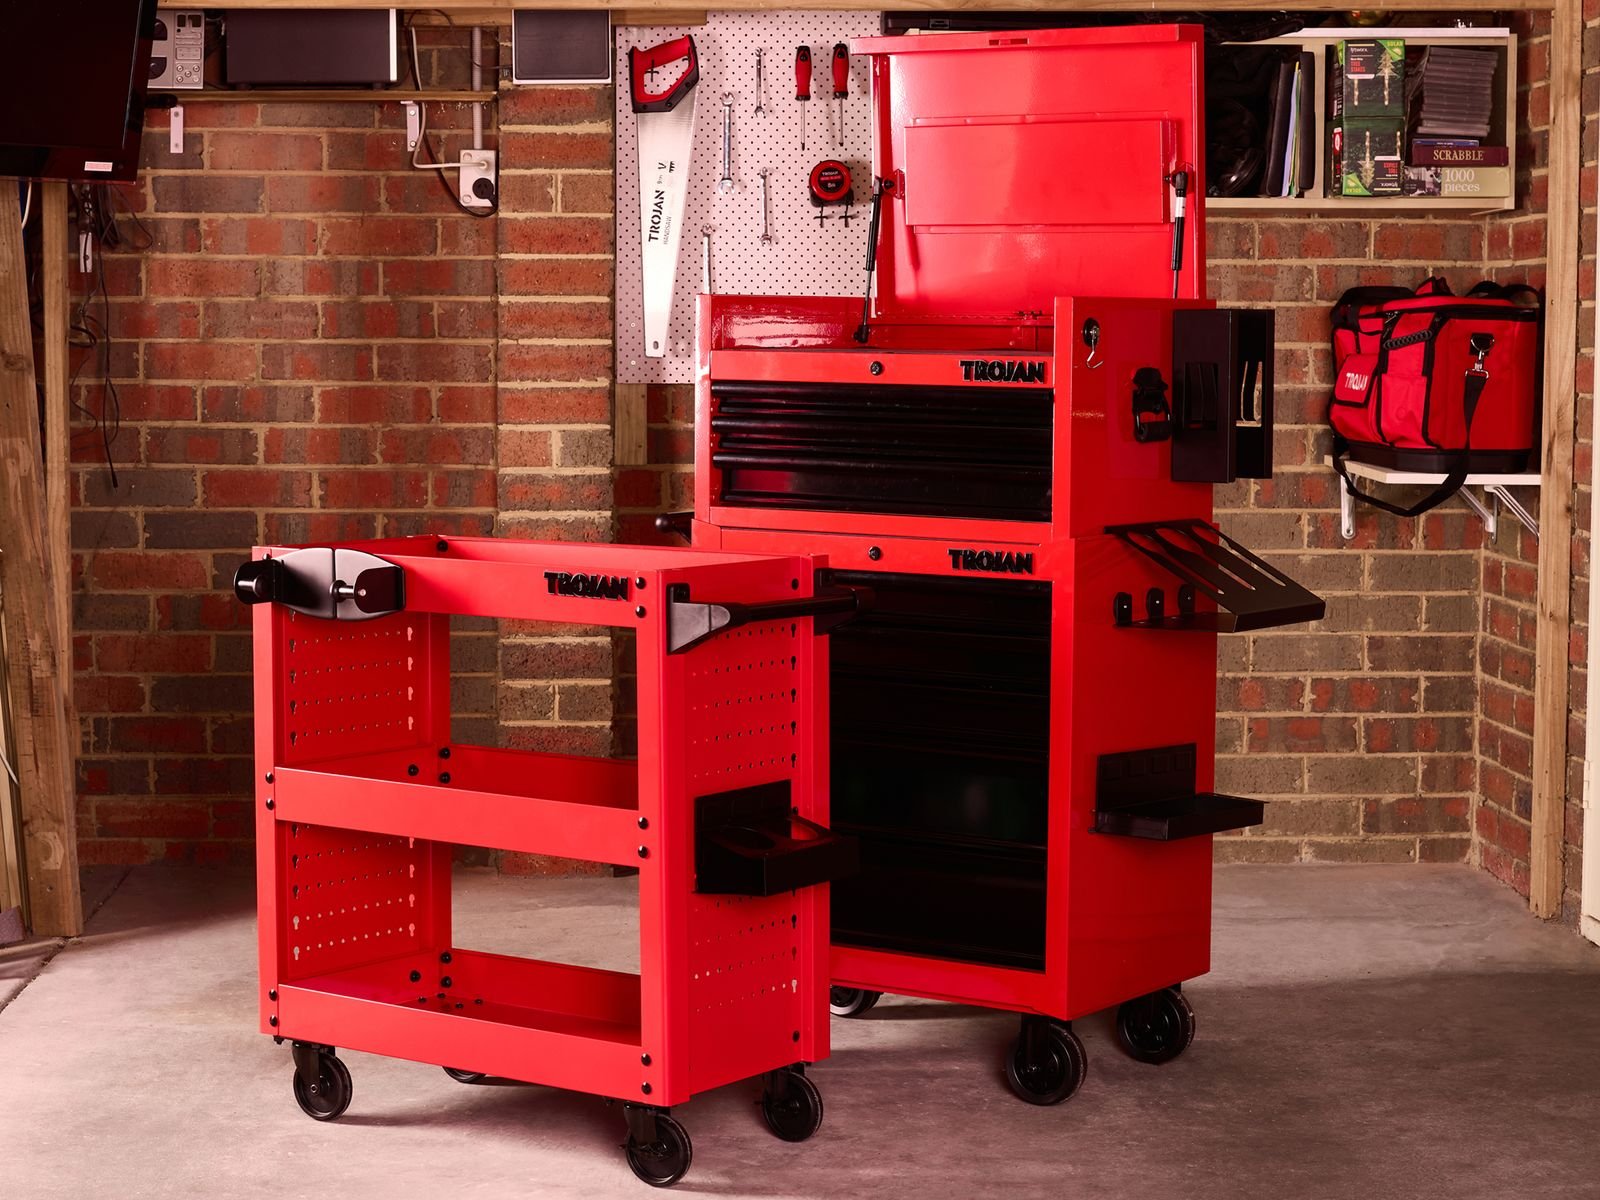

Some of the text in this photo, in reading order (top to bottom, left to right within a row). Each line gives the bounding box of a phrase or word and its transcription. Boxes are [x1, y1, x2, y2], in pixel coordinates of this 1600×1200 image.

[1433, 149, 1484, 161] SCRABBLE
[1444, 182, 1481, 194] pieces
[1445, 169, 1475, 182] 1000
[648, 189, 664, 242] TROJAN
[662, 215, 672, 245] HANDSAW
[960, 359, 1045, 383] TROJAN
[948, 548, 1033, 575] TROJAN
[544, 569, 629, 602] TROJAN
